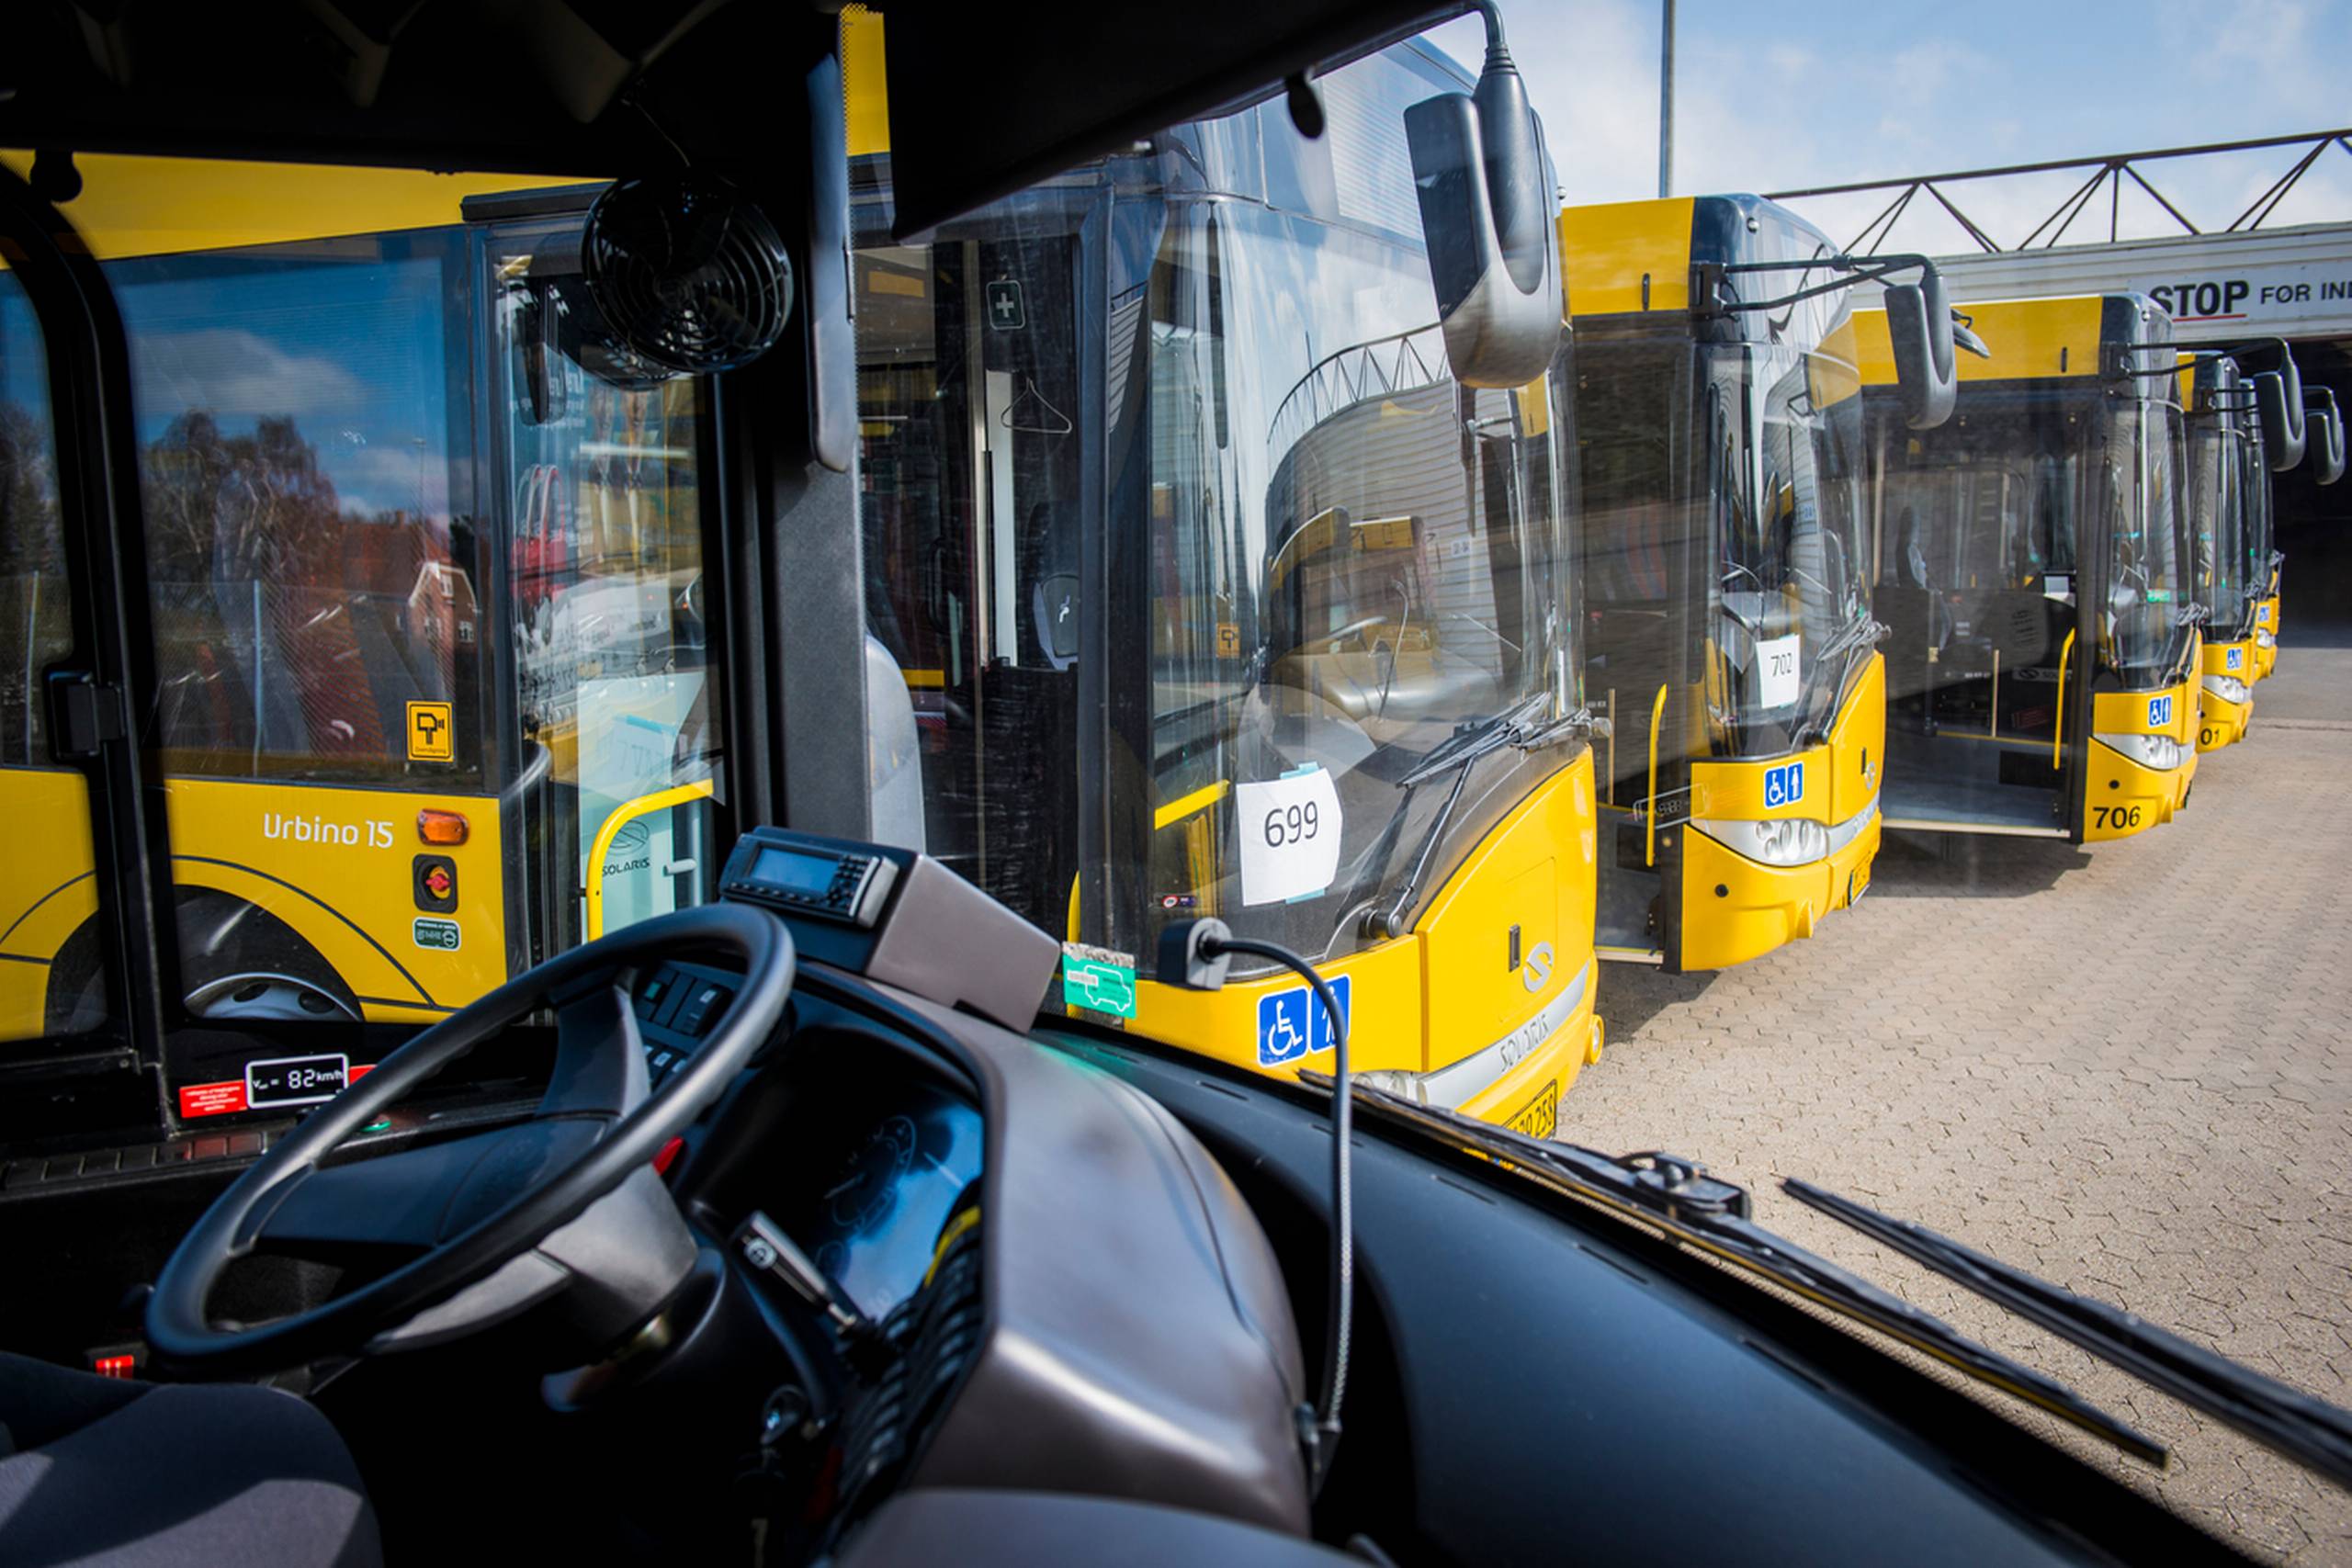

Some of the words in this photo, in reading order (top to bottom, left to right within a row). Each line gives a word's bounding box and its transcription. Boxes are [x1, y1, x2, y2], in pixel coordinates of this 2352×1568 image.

[2150, 279, 2250, 317] STOP
[264, 812, 359, 846] Urbino
[365, 818, 394, 850] 15
[1264, 800, 1318, 848] 699
[2093, 805, 2142, 829] 706
[602, 857, 650, 877] SOLARIS
[288, 1068, 315, 1089] 82
